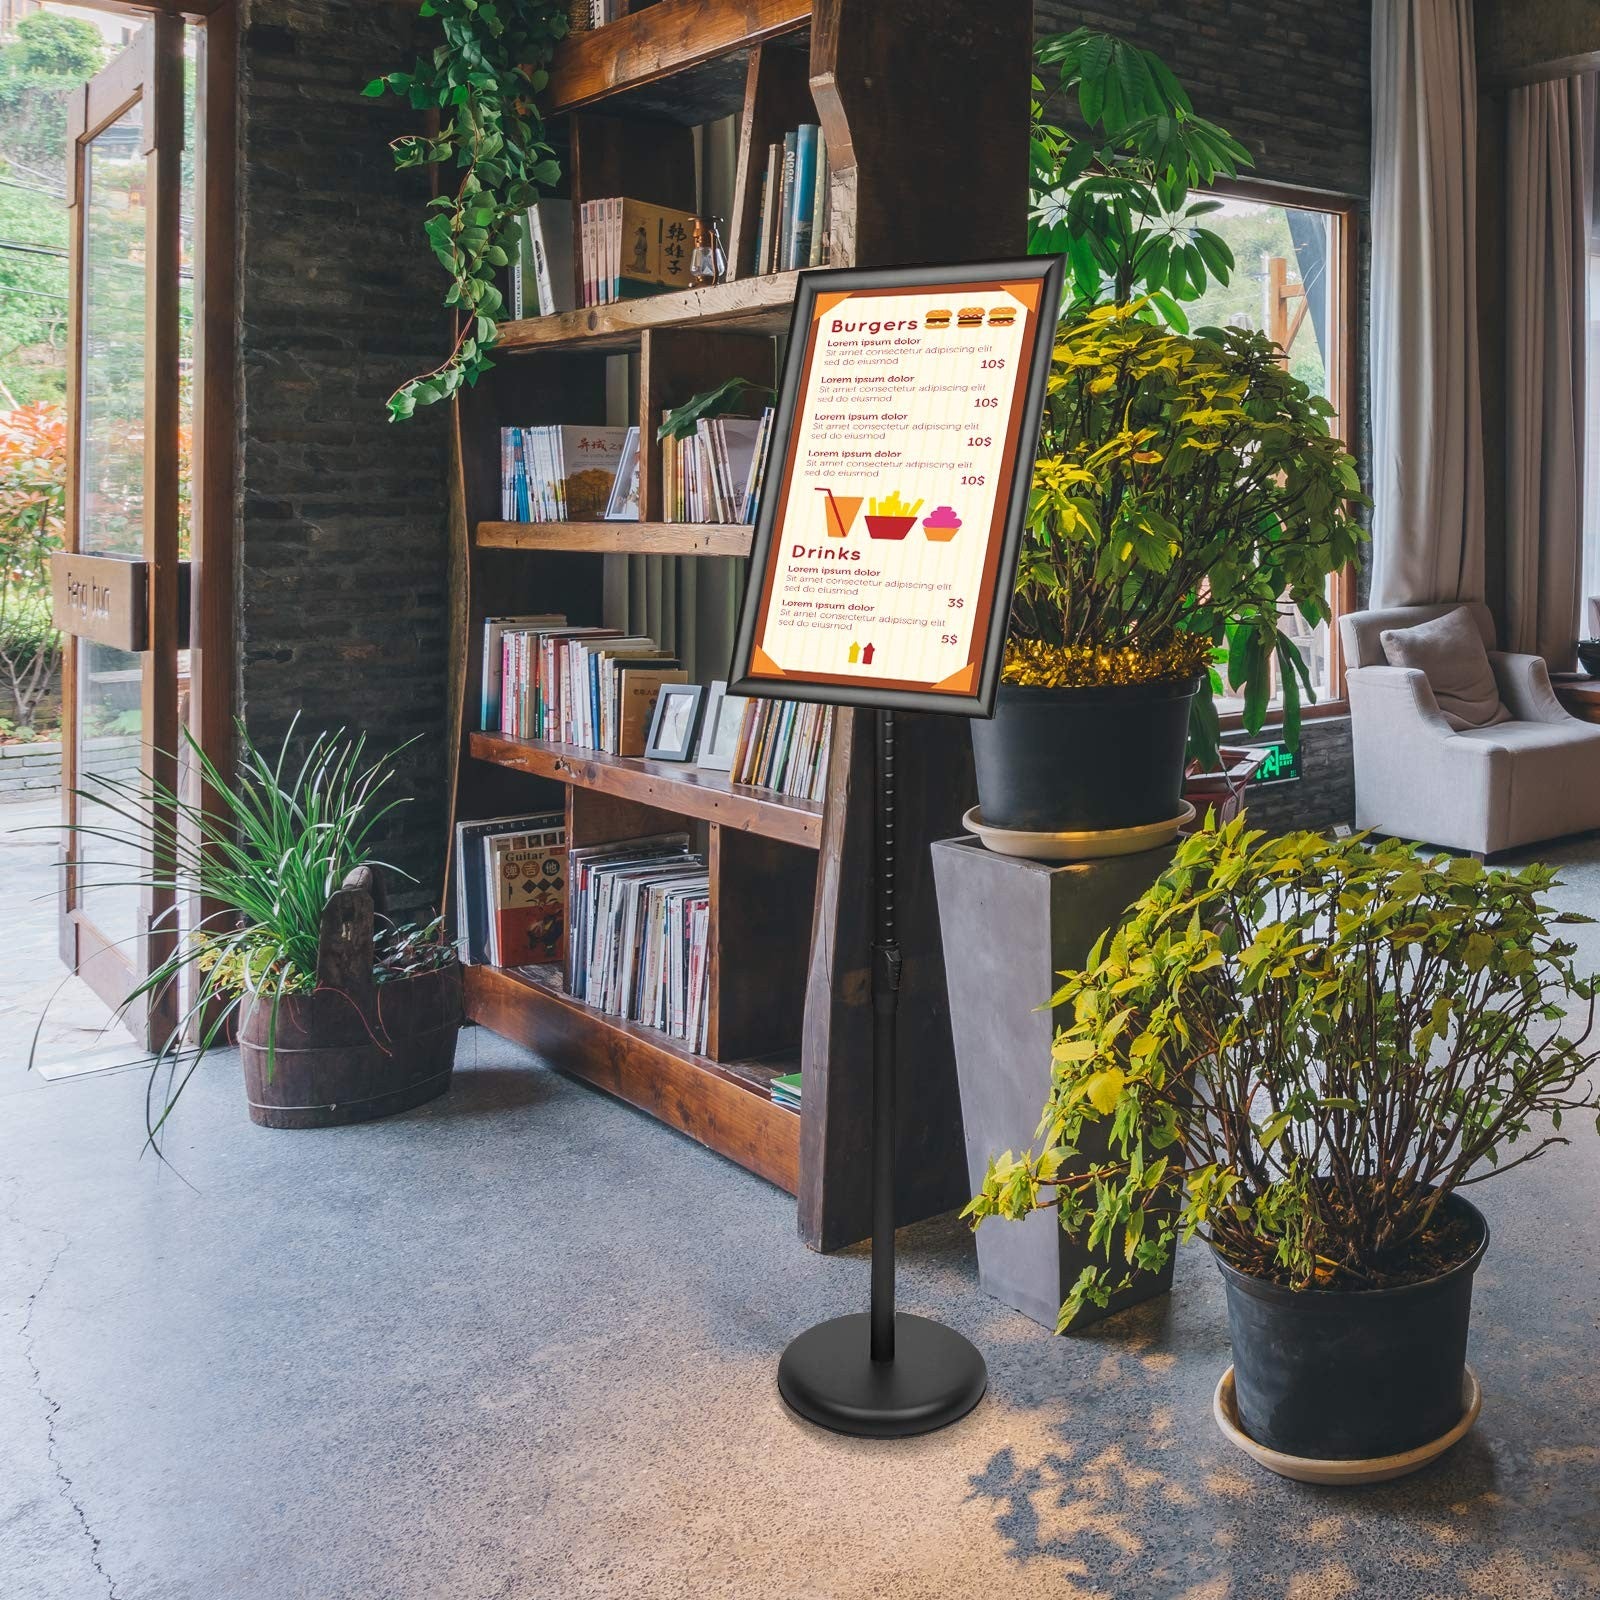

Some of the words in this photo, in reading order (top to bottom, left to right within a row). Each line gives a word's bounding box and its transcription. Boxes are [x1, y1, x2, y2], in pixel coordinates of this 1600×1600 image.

[831, 319, 918, 335] Burgers
[827, 339, 859, 347] Lorem
[860, 338, 892, 348] ipsum
[893, 337, 922, 346] dolor
[825, 349, 837, 357] Sit
[838, 348, 863, 356] amet
[865, 347, 923, 356] consectetur
[924, 345, 976, 356] adipiscing
[977, 344, 993, 353] elit
[823, 358, 841, 366] sed
[842, 358, 856, 366] do
[856, 356, 899, 366] eiusmod
[980, 358, 1006, 370] 10$
[820, 376, 852, 384] Lorem
[854, 375, 885, 385] ipsum
[886, 375, 916, 383] dolor
[818, 385, 830, 394] Sit
[858, 385, 916, 393] consectetur
[918, 383, 969, 393] adipiscing
[970, 383, 986, 392] elit
[817, 395, 834, 403] sed
[835, 395, 849, 403] do
[850, 394, 893, 403] eiusmod
[973, 397, 999, 409] 10$
[814, 412, 846, 421] Lorem
[847, 412, 879, 422] ipsum
[880, 412, 909, 421] dolor
[812, 422, 824, 431] Sit
[825, 423, 850, 431] amet
[852, 423, 910, 431] consectetur
[911, 422, 962, 432] adipiscing
[963, 422, 979, 431] elit
[810, 432, 828, 440] sed
[829, 432, 843, 440] do
[843, 432, 886, 440] eiusmod
[967, 436, 992, 448] 10$
[808, 449, 839, 458] Lorem
[841, 450, 872, 459] ipsum
[873, 450, 903, 458] dolor
[805, 459, 817, 468] Sit
[845, 460, 903, 468] consectetur
[905, 460, 956, 471] adipiscing
[957, 461, 973, 469] elit
[804, 468, 821, 477] sed
[822, 469, 836, 477] do
[837, 469, 880, 478] eiusmod
[960, 474, 986, 487] 10$
[791, 544, 861, 561] Drinks
[787, 564, 819, 574] Lorem
[821, 566, 852, 576] ipsum
[853, 568, 881, 577] dolor
[785, 574, 798, 583] Sit
[798, 576, 824, 584] amet
[825, 578, 883, 587] consectetur
[884, 580, 935, 592] adipiscing
[936, 583, 952, 591] elit
[783, 584, 801, 592] sed
[802, 584, 816, 593] do
[817, 586, 859, 596] eiusmod
[781, 599, 813, 608] Lorem
[814, 601, 846, 610] ipsum
[847, 603, 876, 612] dolor
[947, 597, 965, 609] 3$
[779, 608, 791, 617] Sit
[792, 609, 817, 619] amet
[819, 612, 876, 622] consectetur
[878, 615, 929, 628] adipiscing
[930, 619, 946, 627] elit
[777, 618, 795, 626] sed
[796, 619, 810, 628] do
[811, 621, 853, 631] eiusmod
[940, 633, 958, 646] 5$
[466, 821, 526, 834] LIONEL
[505, 852, 545, 862] Guitar
